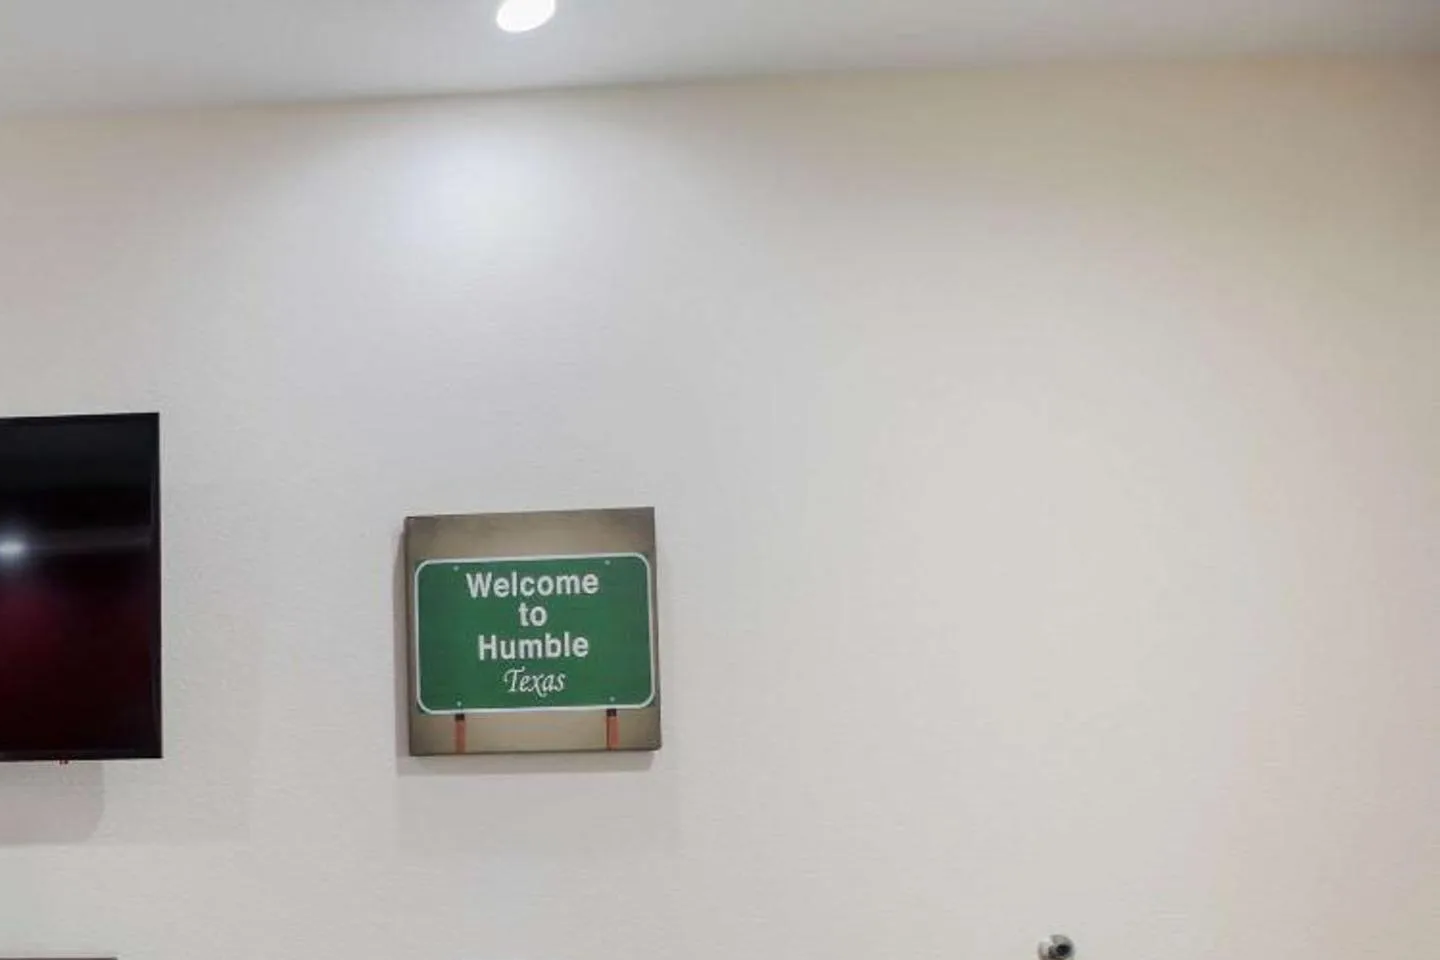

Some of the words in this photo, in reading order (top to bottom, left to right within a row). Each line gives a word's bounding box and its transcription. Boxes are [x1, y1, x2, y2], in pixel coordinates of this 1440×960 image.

[466, 571, 600, 598] Welcome
[518, 602, 548, 627] to
[477, 631, 589, 661] Humble
[504, 666, 566, 698] Texas
